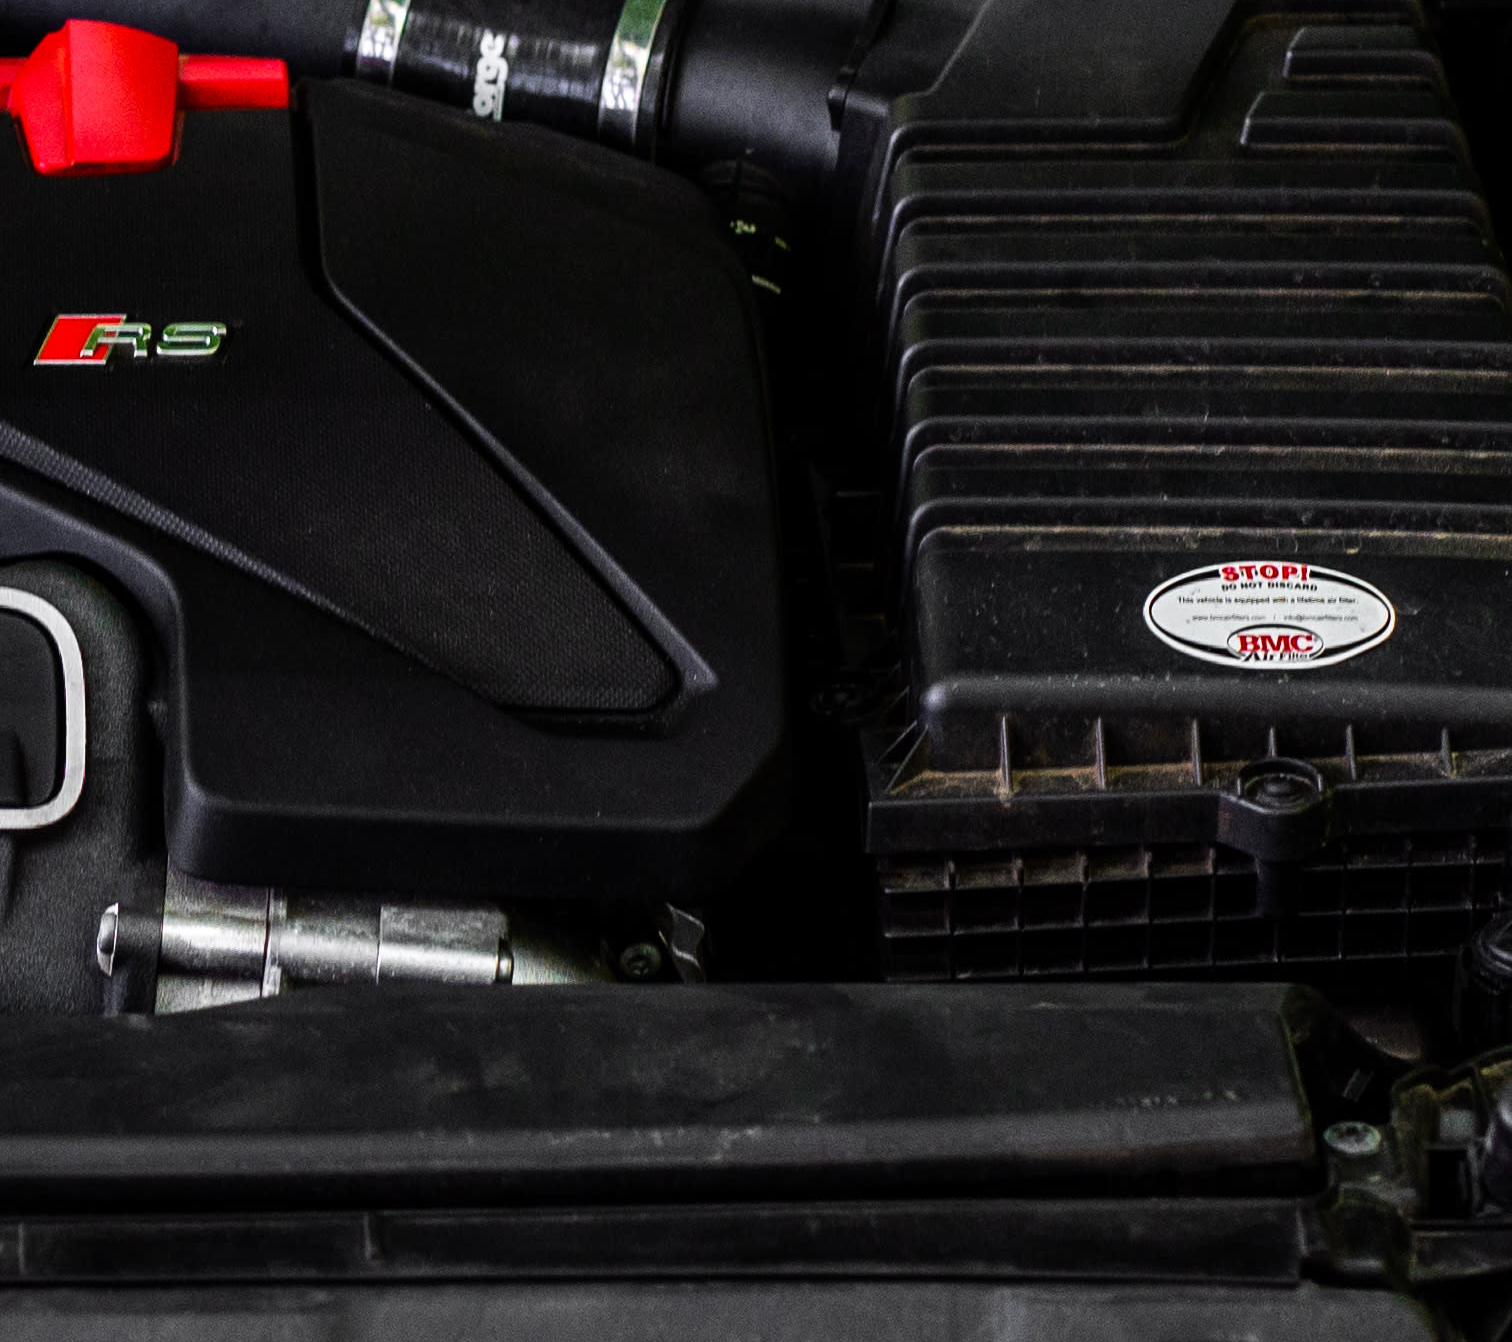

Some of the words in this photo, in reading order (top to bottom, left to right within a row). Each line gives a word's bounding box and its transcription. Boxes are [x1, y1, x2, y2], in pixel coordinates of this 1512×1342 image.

[76, 320, 228, 359] RS
[1221, 564, 1308, 581] STOP!
[1221, 583, 1237, 592] DO
[1240, 581, 1263, 590] NOT
[1267, 581, 1318, 592] DISCARD
[1237, 633, 1314, 653] BMC
